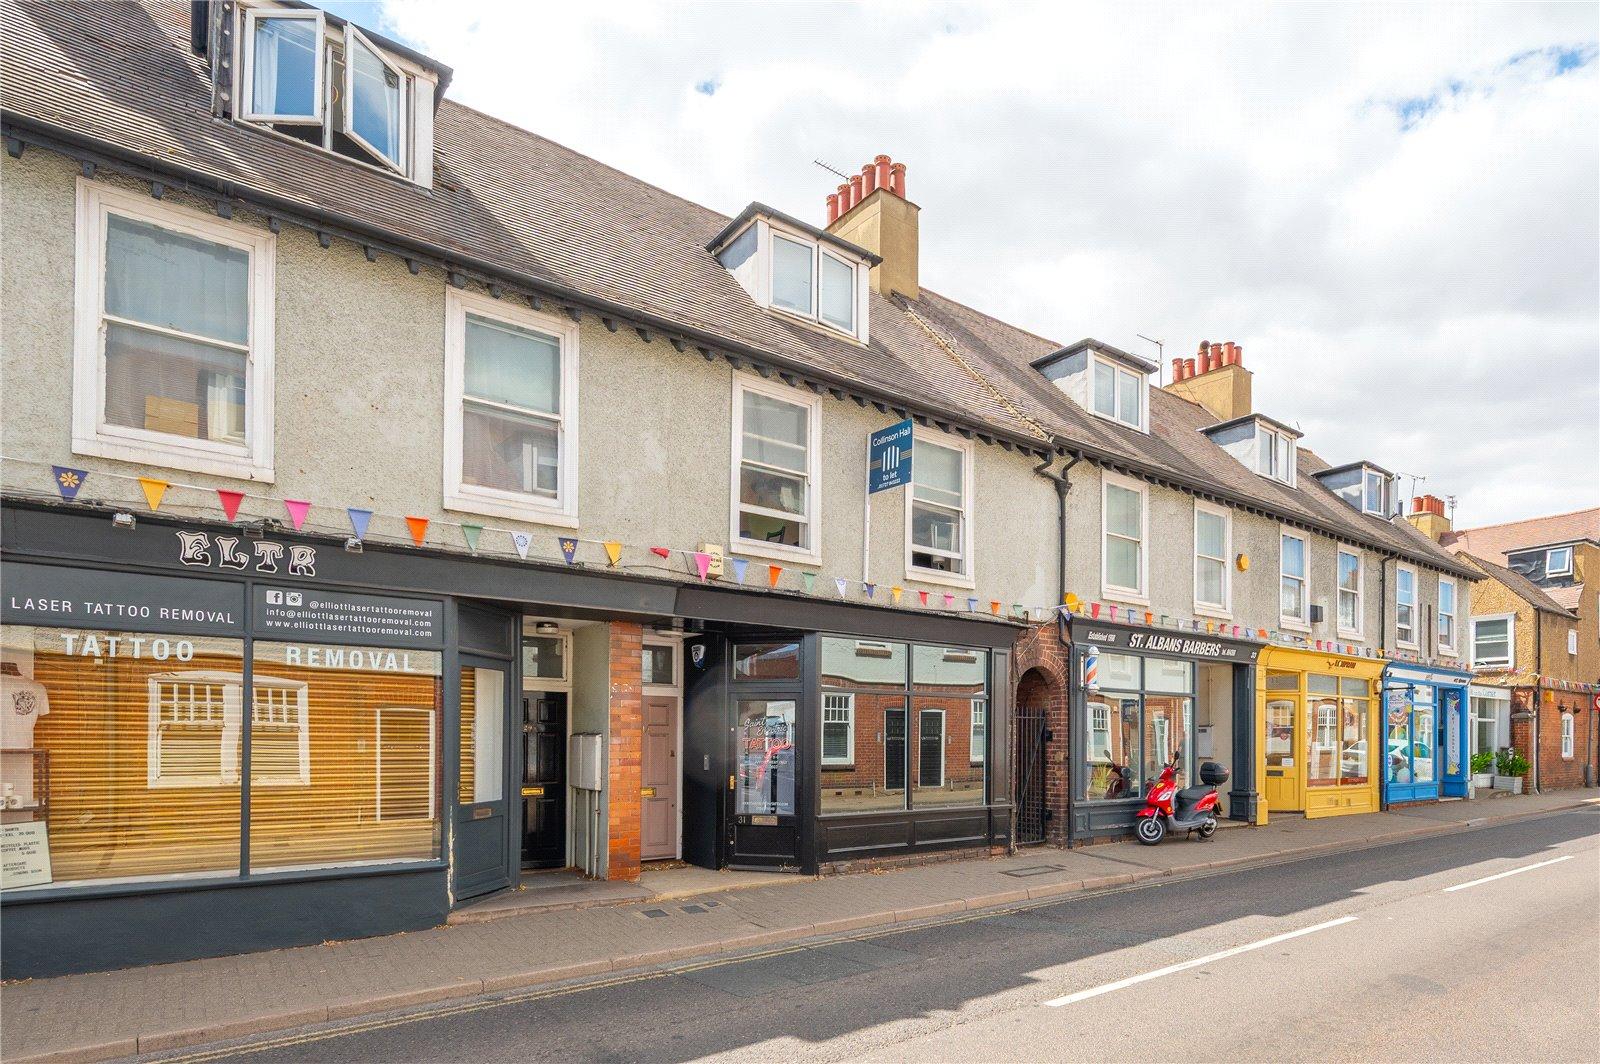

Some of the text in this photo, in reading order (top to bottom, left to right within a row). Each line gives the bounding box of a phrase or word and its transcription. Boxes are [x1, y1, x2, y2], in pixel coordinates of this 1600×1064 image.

[873, 427, 911, 446] Collinson Hall
[176, 530, 316, 577] ELTR
[11, 597, 235, 625] LASER TATTOO REMOVAL
[266, 608, 431, 627] info@elliottlasertattooremoval.com
[309, 600, 432, 617] @elliottlasertattooremoval
[266, 620, 432, 637] www.elliottlasertattooremoval.com
[60, 633, 415, 672] TATTOO REMOVAL
[1129, 633, 1144, 648] ST.
[1145, 635, 1182, 652] ALBANS
[1182, 640, 1222, 657] BARBERS
[742, 737, 791, 750] TATTOO
[738, 815, 746, 824] 31
